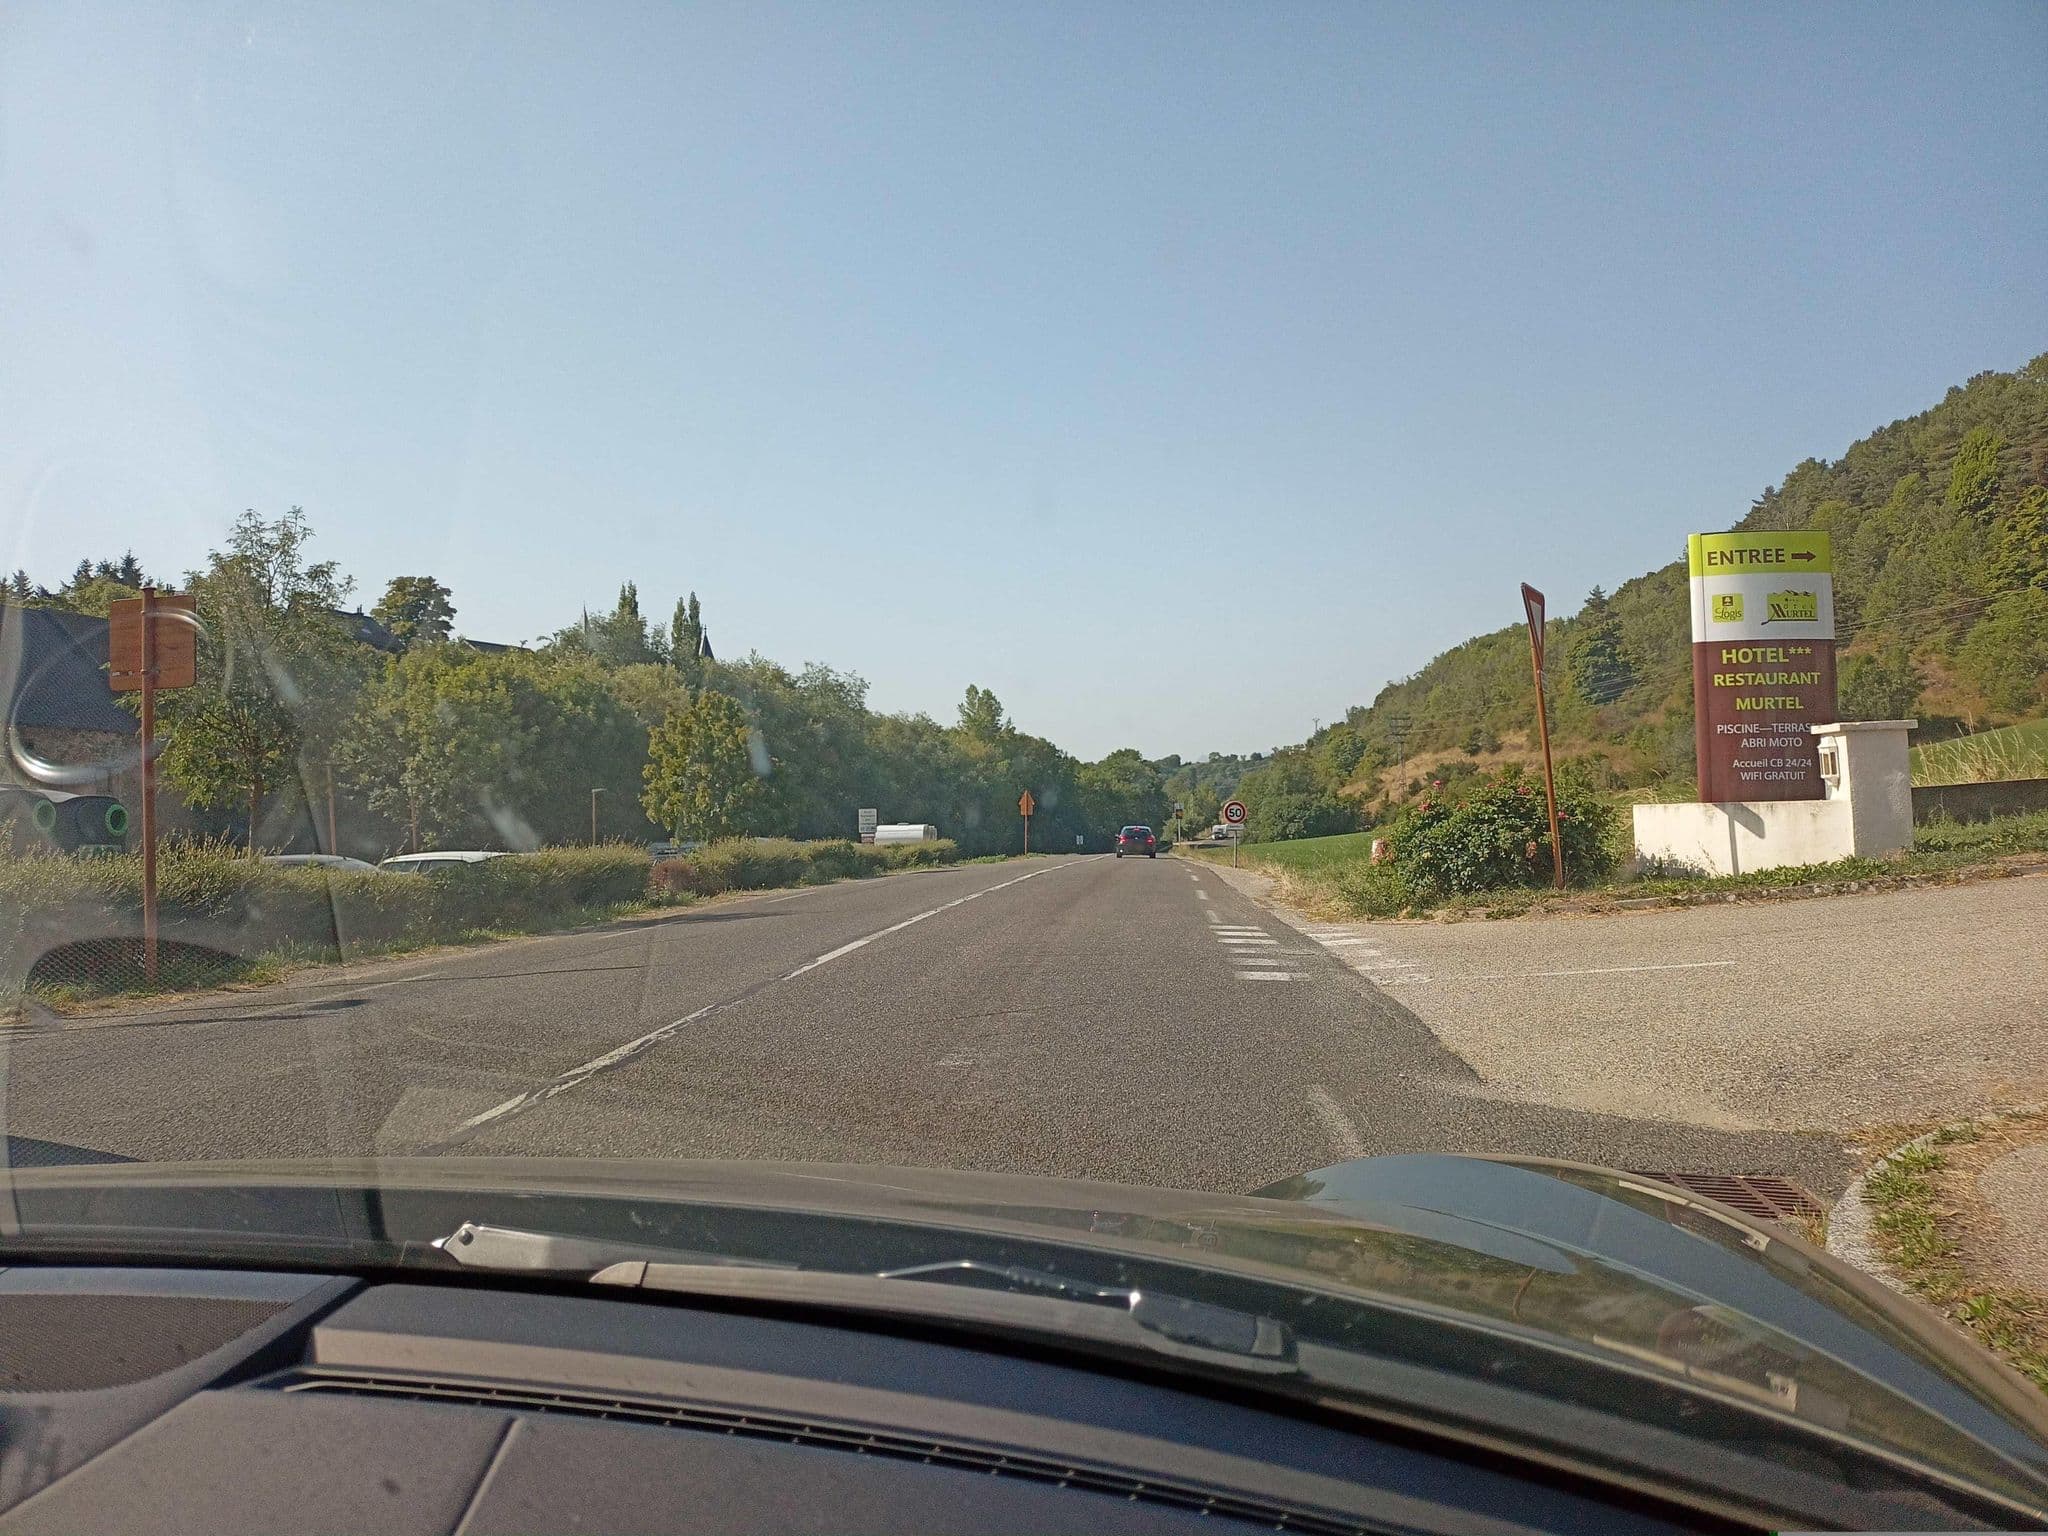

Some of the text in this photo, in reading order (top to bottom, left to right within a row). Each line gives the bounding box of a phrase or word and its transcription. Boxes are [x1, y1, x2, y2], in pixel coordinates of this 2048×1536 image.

[1707, 548, 1786, 567] ENTREE
[1713, 672, 1821, 687] RESTAURANT
[1735, 696, 1804, 711] MURTEL
[1740, 737, 1803, 748] ABRI MOTO
[1732, 758, 1812, 769] Accueil CB 24/24
[1740, 771, 1806, 781] WIFI GRATUIT
[1229, 808, 1242, 818] 50
